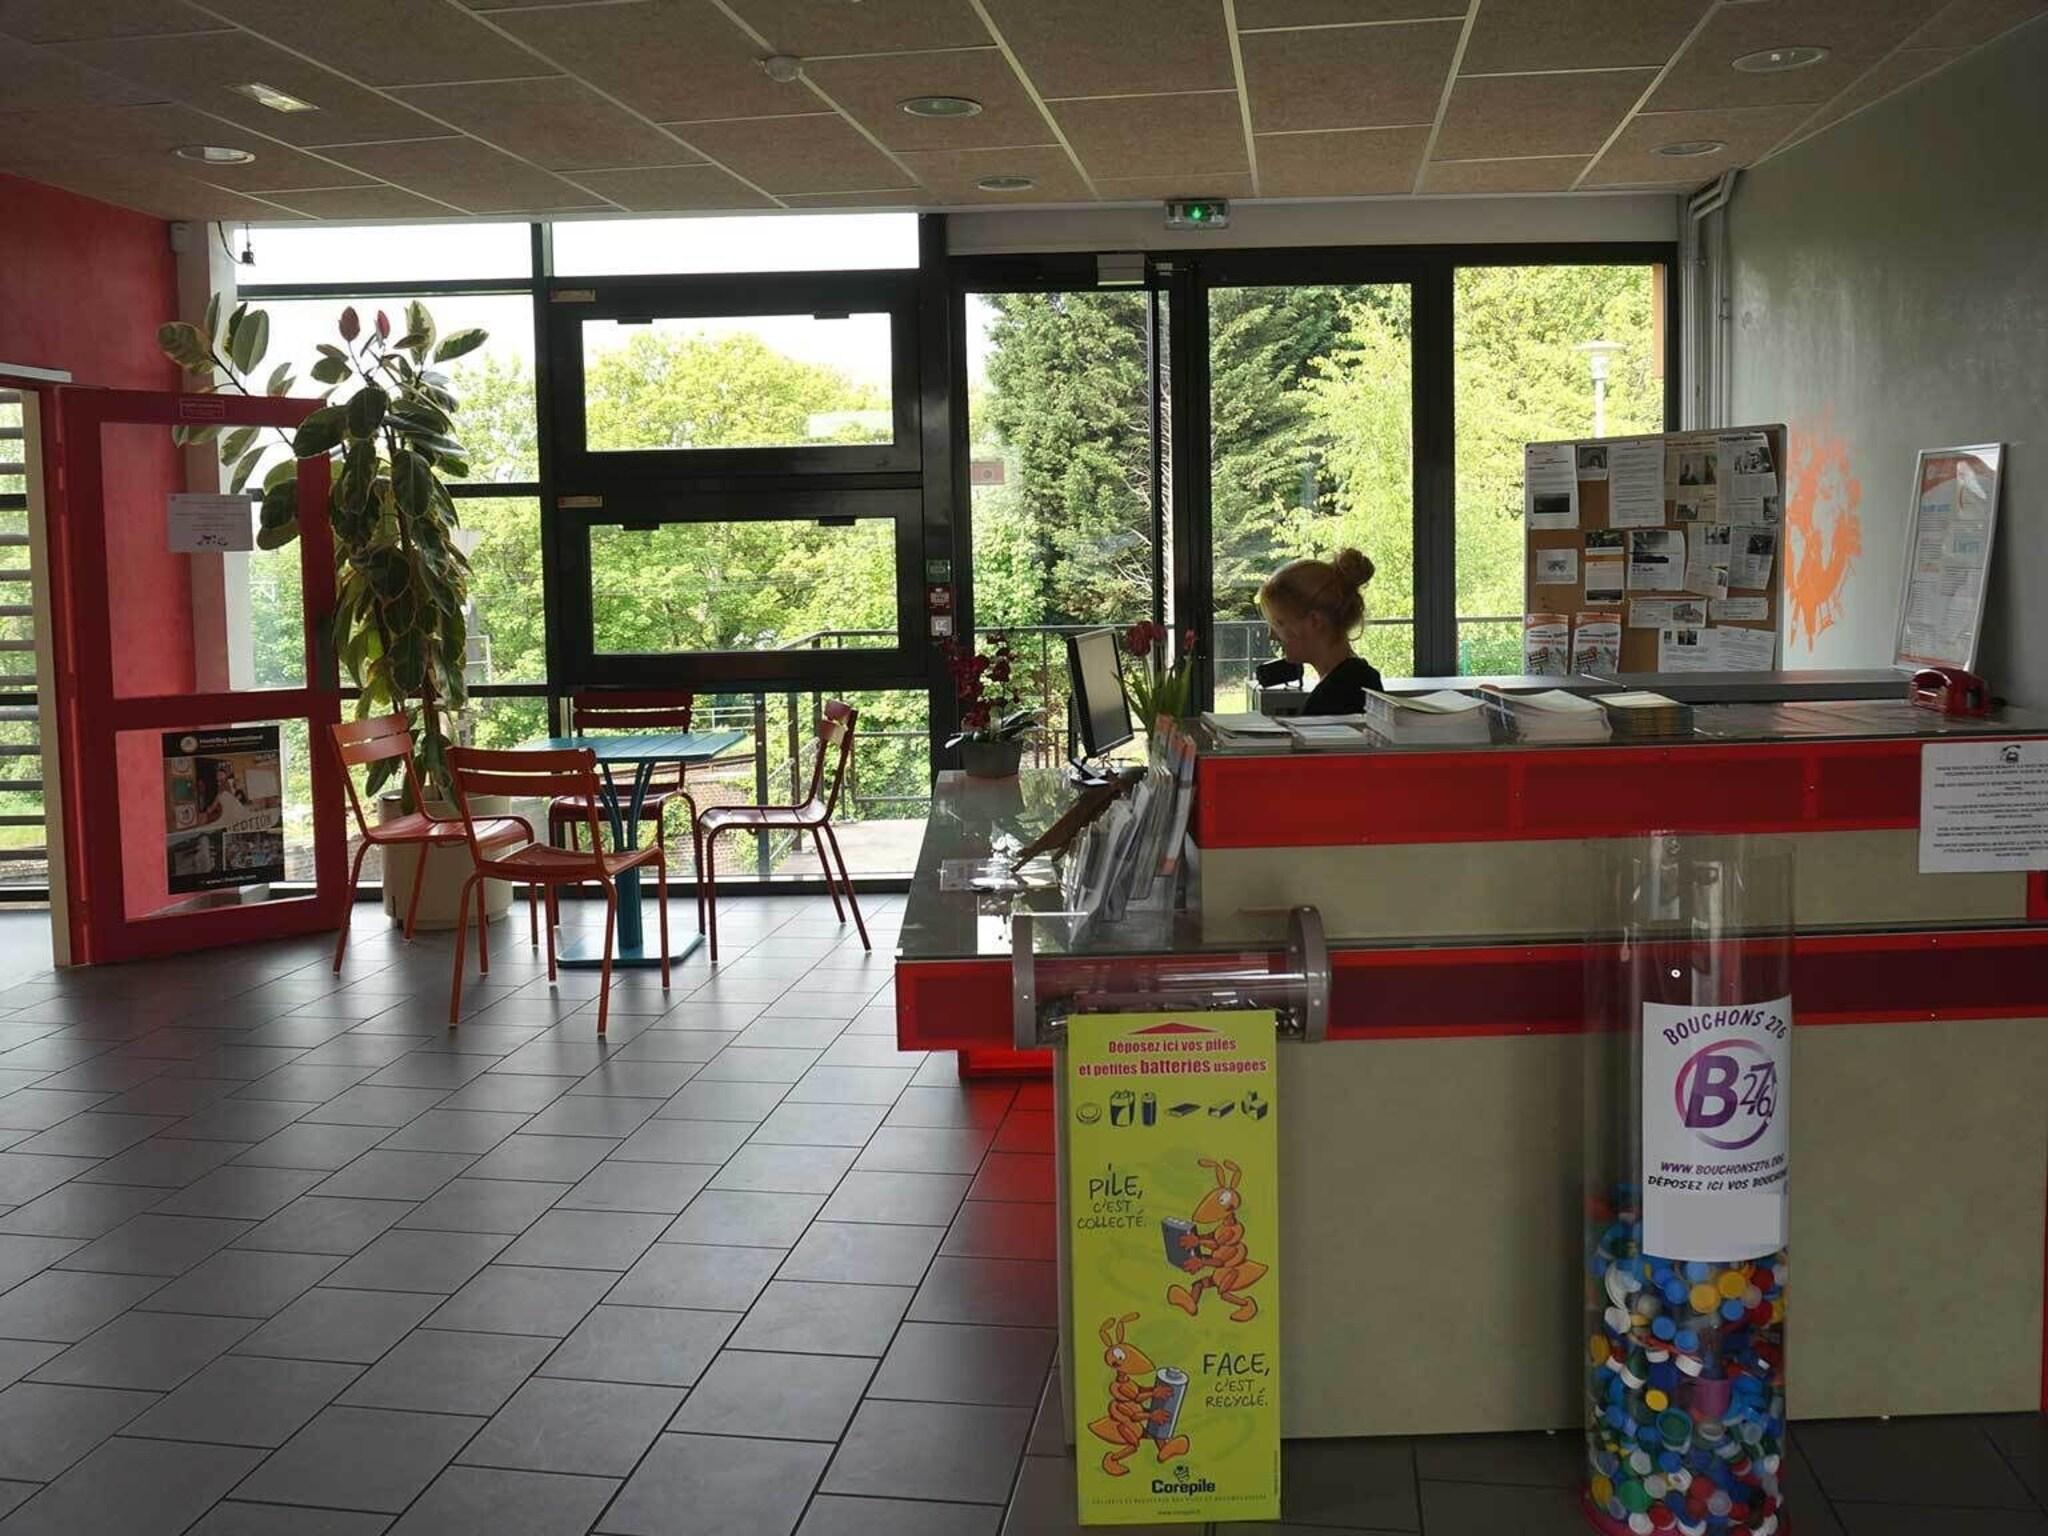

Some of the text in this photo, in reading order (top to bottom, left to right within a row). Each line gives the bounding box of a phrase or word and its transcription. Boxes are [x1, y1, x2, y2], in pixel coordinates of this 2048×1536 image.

[1663, 1009, 1787, 1046] BOUCHONS 276
[1163, 1039, 1178, 1052] ici
[1181, 1040, 1202, 1052] vos
[1206, 1038, 1236, 1053] piles
[1079, 1064, 1091, 1076] et
[1094, 1062, 1138, 1077] petites
[1140, 1059, 1211, 1075] batteries
[1707, 1179, 1723, 1191] ICI
[1727, 1178, 1749, 1191] VOS
[1093, 1200, 1131, 1214] C'EST
[1203, 1353, 1270, 1377] FACE,
[1215, 1378, 1255, 1393] C'EST
[1151, 1479, 1216, 1496] Corepile
